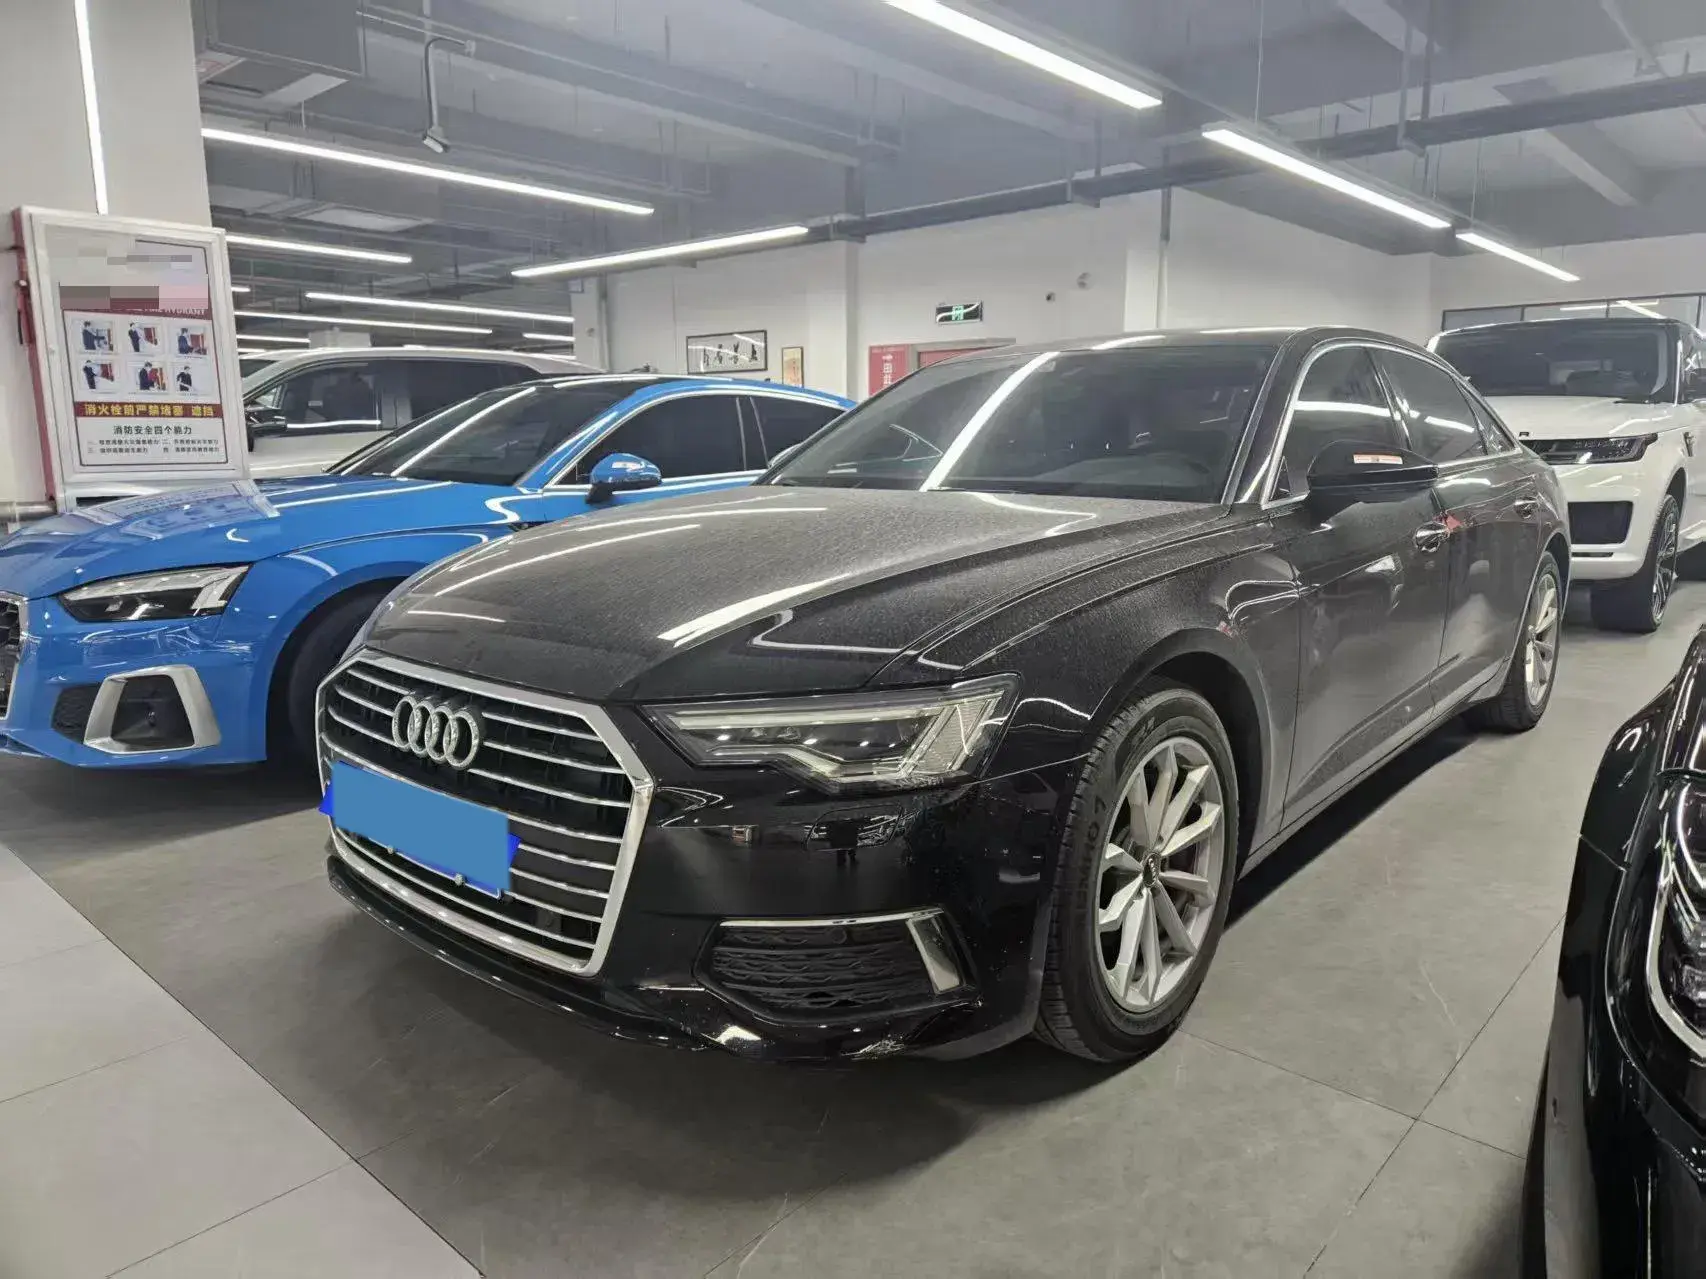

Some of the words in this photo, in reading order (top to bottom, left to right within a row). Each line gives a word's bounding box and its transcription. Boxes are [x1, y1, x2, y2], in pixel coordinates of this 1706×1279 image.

[113, 425, 193, 435] 消防安全四个能力
